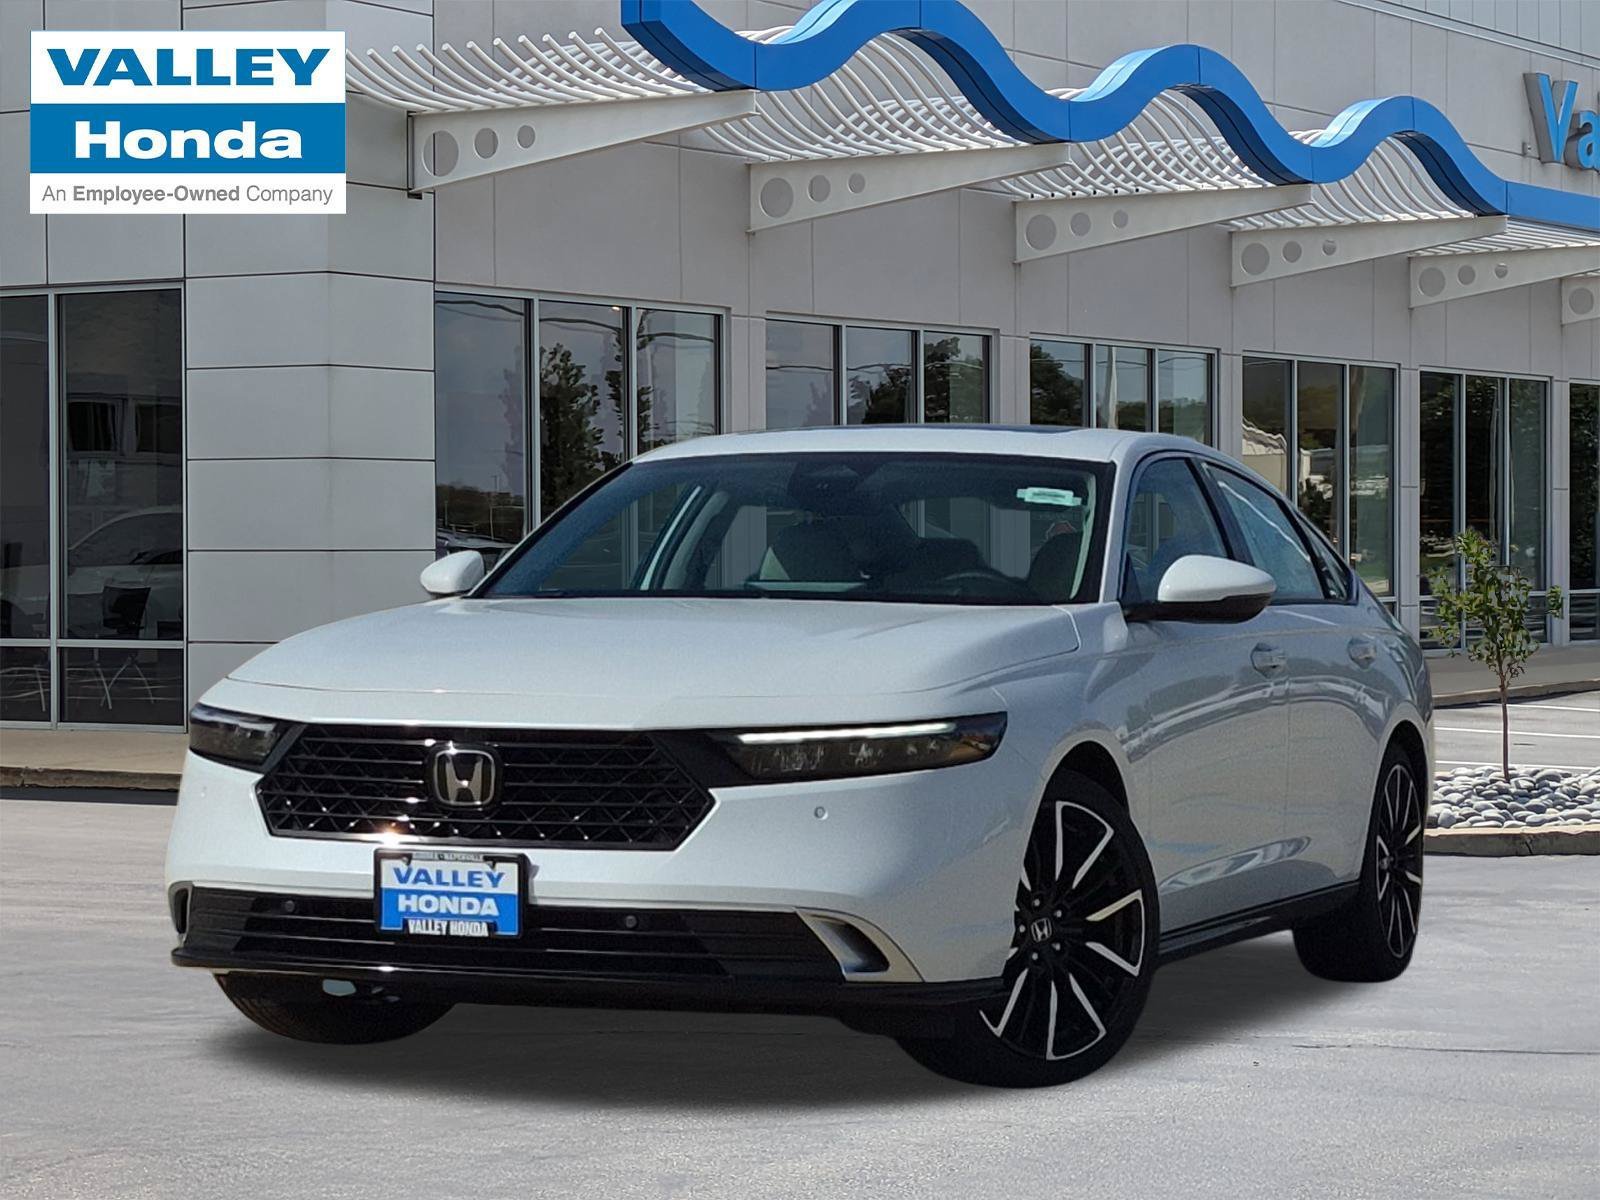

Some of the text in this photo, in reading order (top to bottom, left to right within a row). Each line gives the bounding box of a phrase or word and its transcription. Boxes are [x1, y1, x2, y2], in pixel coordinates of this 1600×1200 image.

[393, 867, 505, 888] VALLEY
[397, 894, 500, 916] HONDA
[407, 918, 490, 937] VALLEY HONDA
